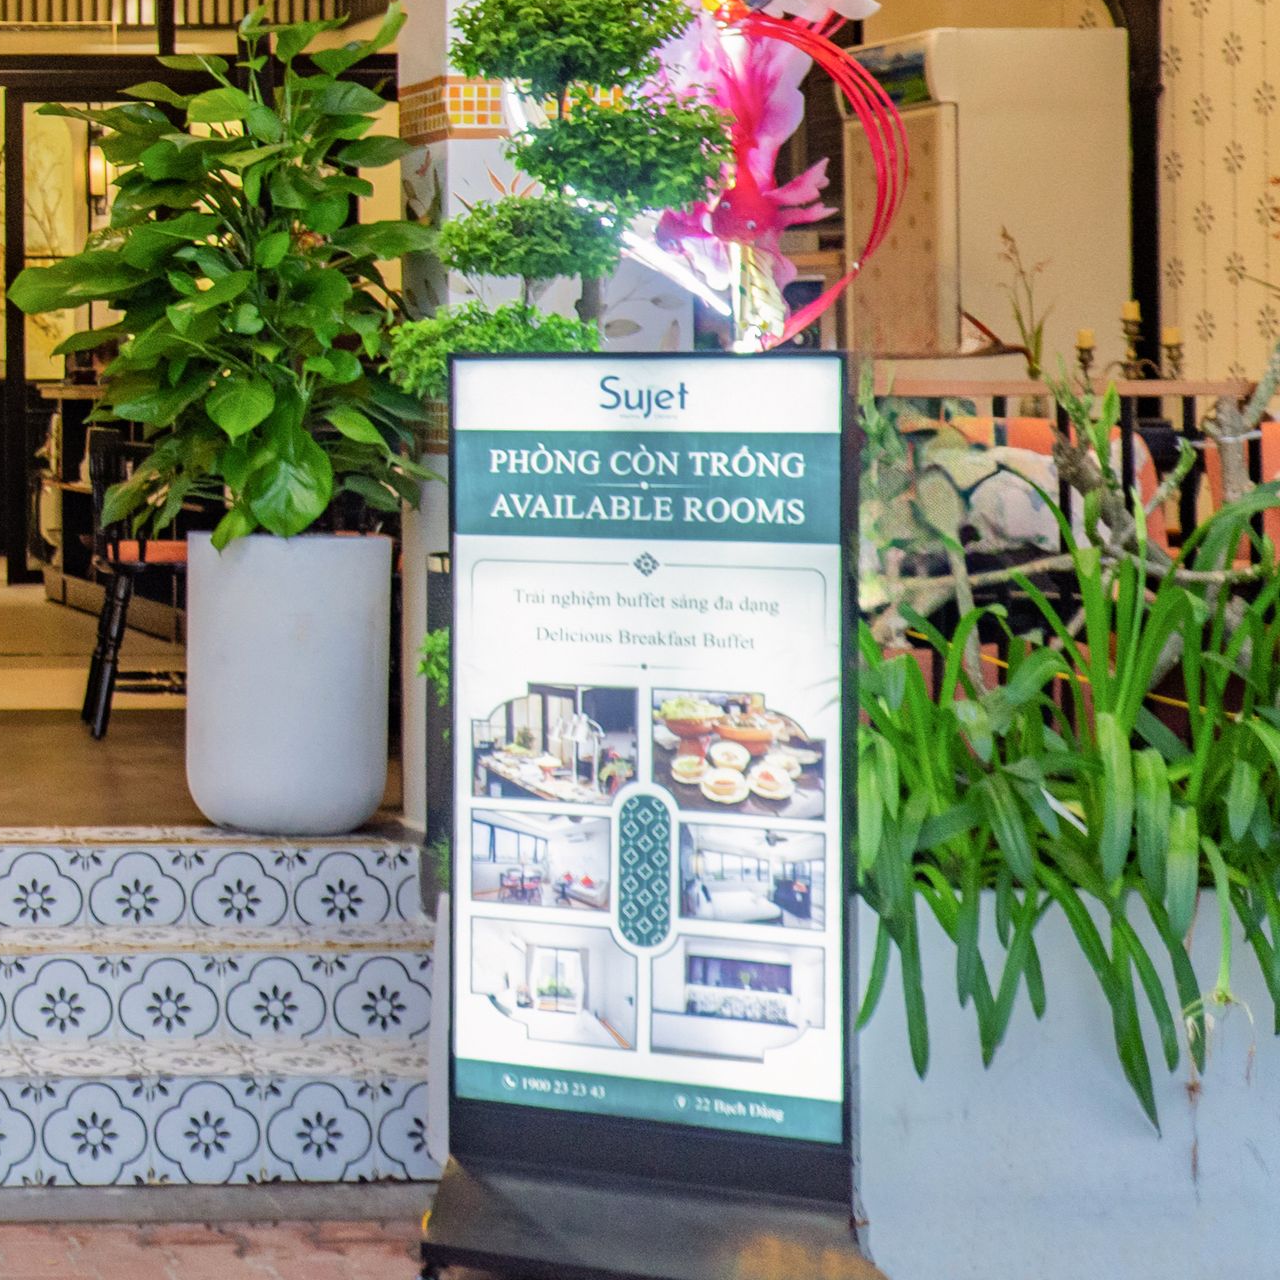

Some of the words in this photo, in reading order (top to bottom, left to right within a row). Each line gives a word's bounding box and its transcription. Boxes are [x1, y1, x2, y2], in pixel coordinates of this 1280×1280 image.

[599, 375, 689, 419] Sujet
[489, 442, 601, 476] PHÒNG
[609, 443, 680, 477] CÒN
[688, 444, 807, 479] TRỐNG
[490, 493, 674, 522] AVAILABLE
[683, 496, 806, 526] ROOMS
[616, 591, 666, 609] buffet
[536, 625, 613, 644] Delicious
[619, 628, 697, 648] Breakfast
[703, 631, 756, 650] Buffet
[522, 1077, 552, 1093] 1900
[553, 1080, 569, 1095] 23
[572, 1082, 587, 1097] 23
[695, 1096, 711, 1112] 22
